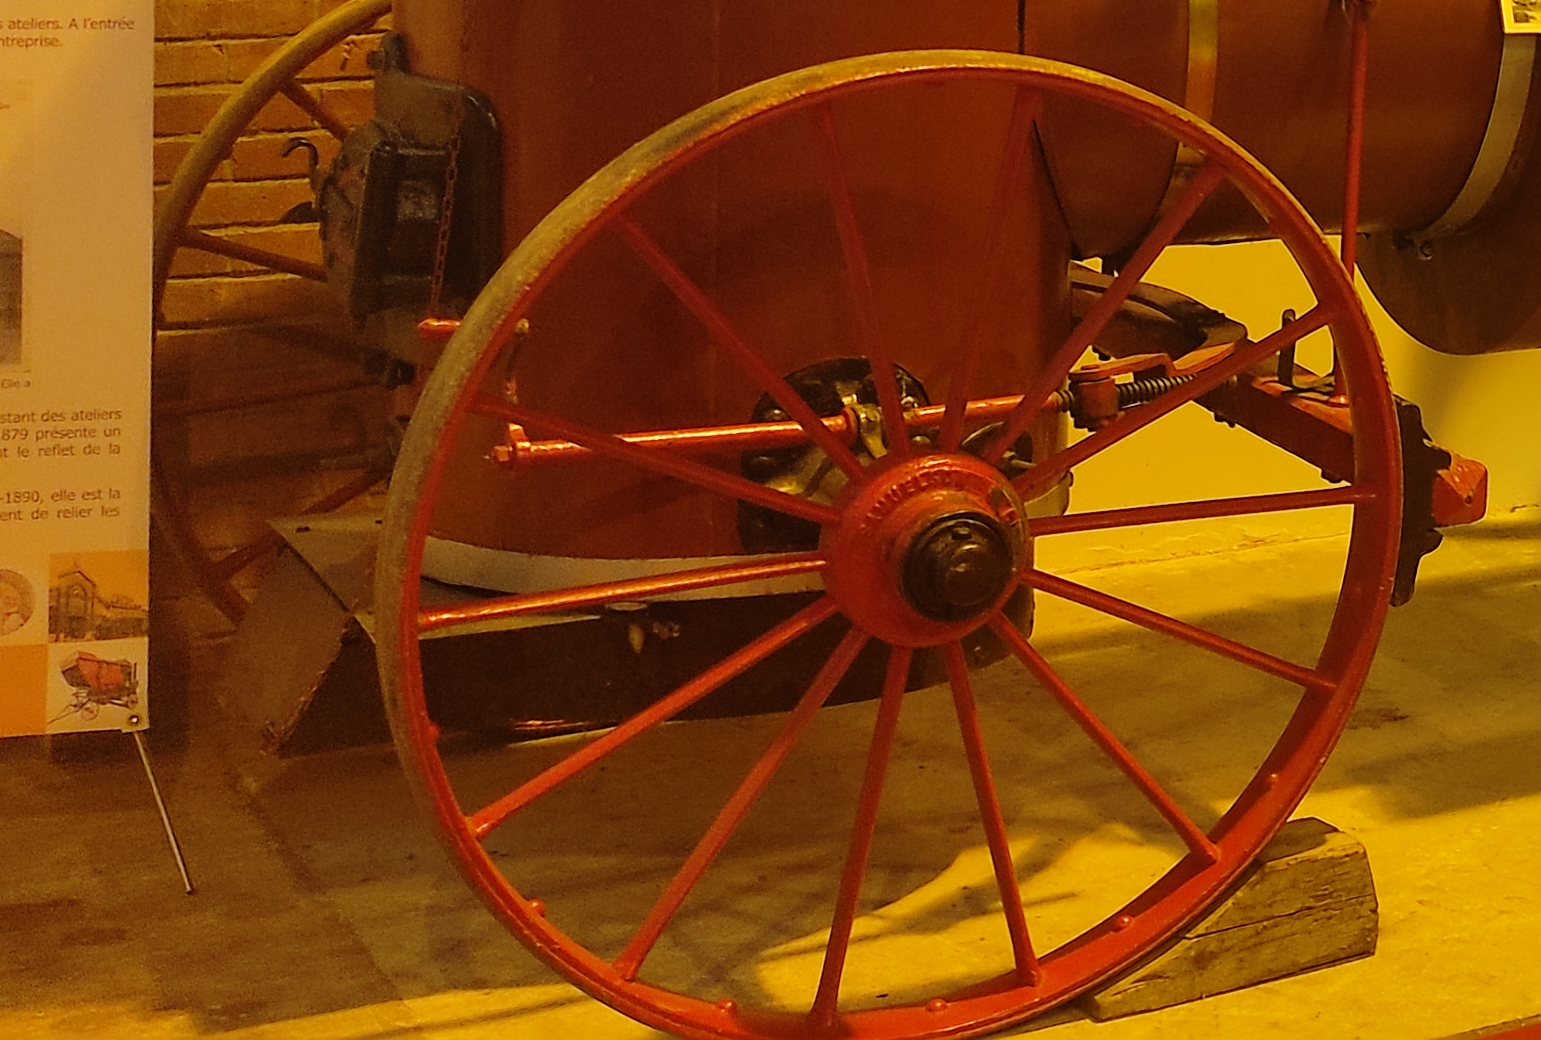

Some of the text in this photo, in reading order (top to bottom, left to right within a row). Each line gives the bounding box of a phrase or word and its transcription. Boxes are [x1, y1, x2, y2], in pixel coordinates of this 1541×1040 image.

[8, 18, 63, 30] ateliers.
[83, 16, 134, 30] l'entrée
[40, 410, 66, 422] des
[71, 408, 122, 422] ateliers
[35, 427, 96, 442] présente
[103, 427, 121, 438] un
[17, 443, 121, 458] le reflet de la
[50, 489, 76, 502] elle
[81, 489, 102, 501] est
[109, 488, 121, 499] la
[31, 508, 48, 520] de
[56, 506, 93, 519] relier
[101, 505, 120, 517] les
